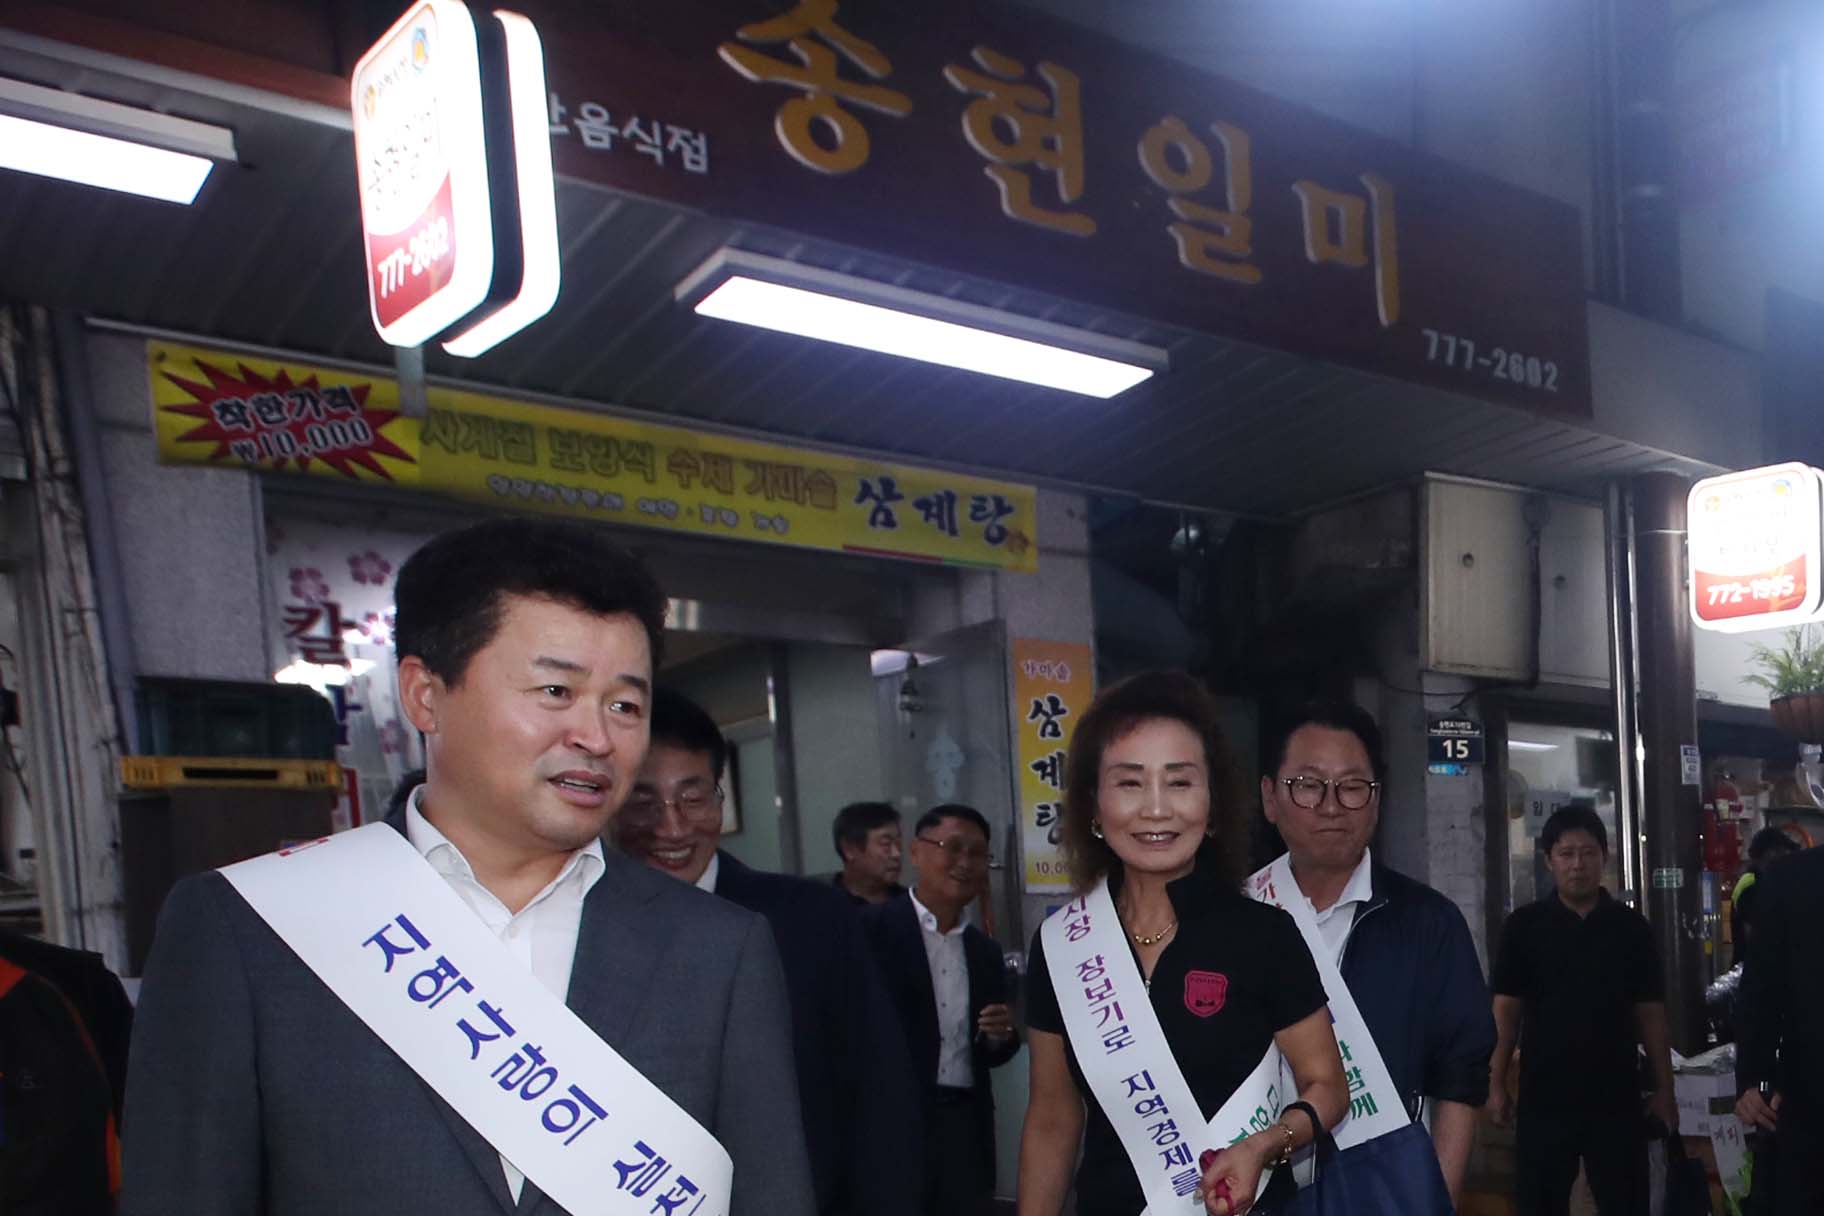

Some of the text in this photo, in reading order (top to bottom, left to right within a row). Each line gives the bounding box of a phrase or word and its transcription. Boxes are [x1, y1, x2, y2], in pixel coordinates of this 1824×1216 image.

[718, 0, 1402, 328] 송현일미
[211, 384, 360, 430] 착한가격
[421, 409, 538, 466] 사계절
[547, 427, 657, 483] 보양식
[854, 474, 1017, 547] 삼계탕
[1442, 739, 1469, 758] 15
[1075, 953, 1136, 1056] 장보기로
[1120, 1069, 1201, 1198] 지역경제를
